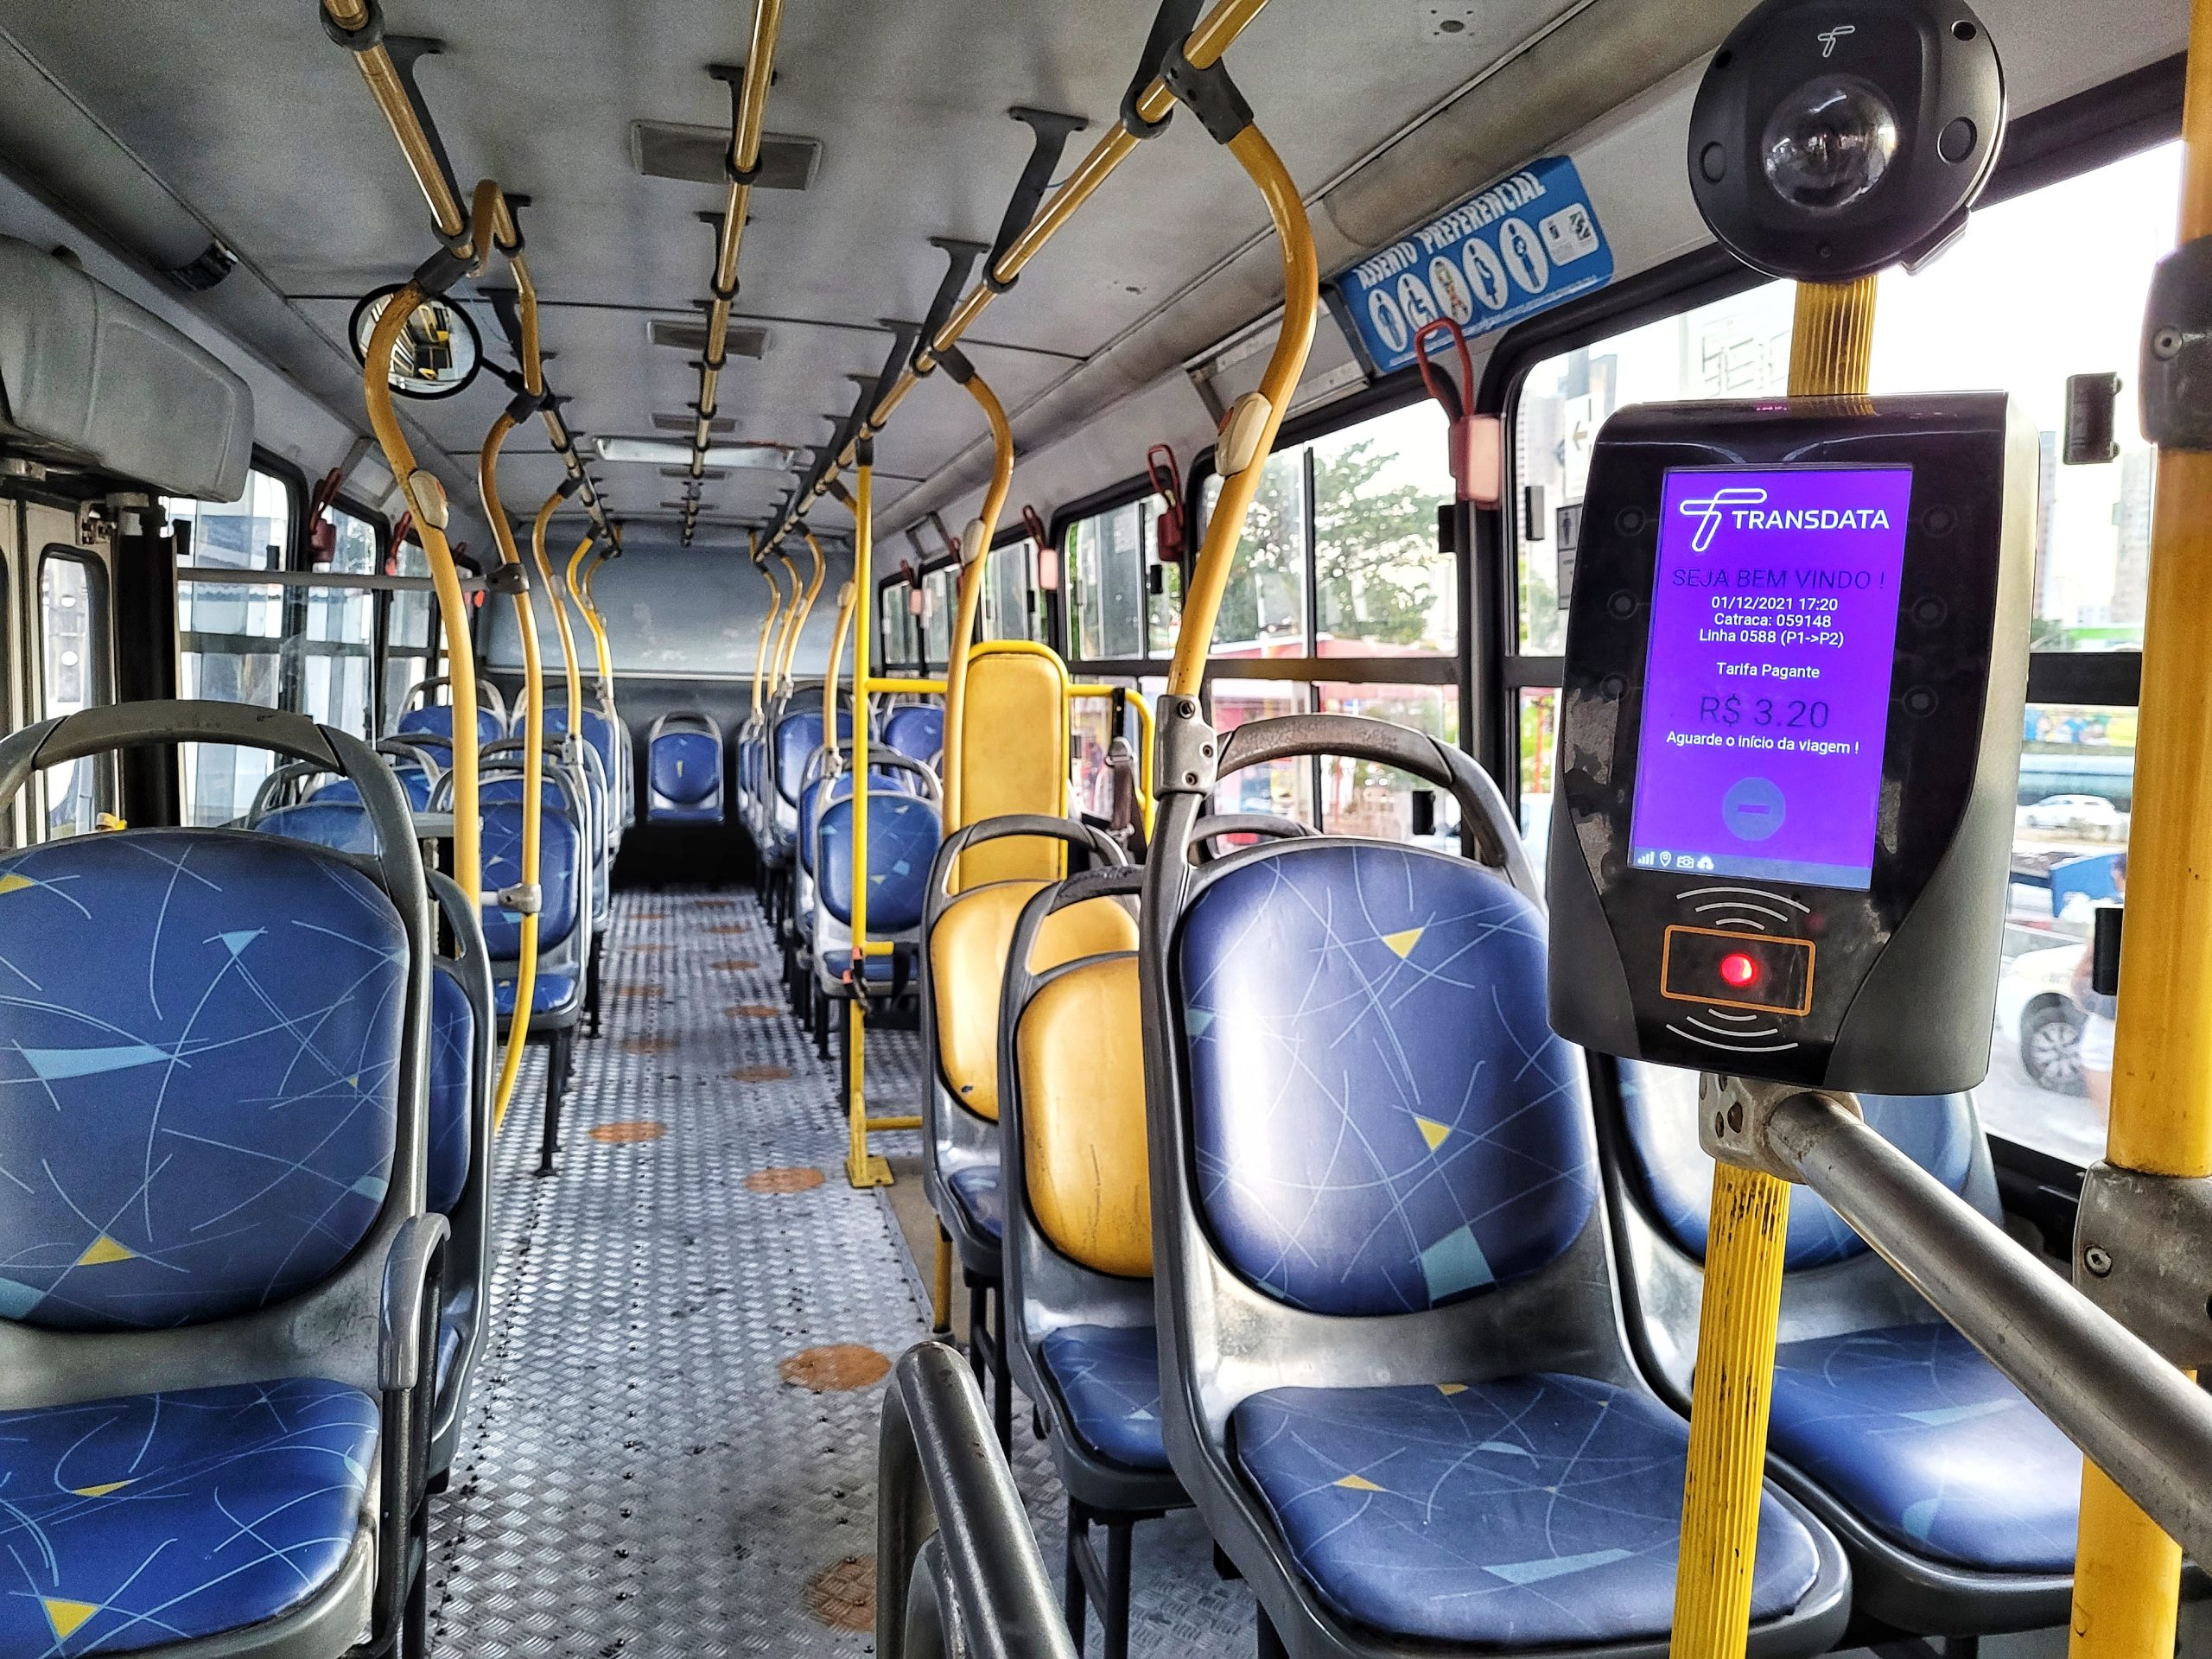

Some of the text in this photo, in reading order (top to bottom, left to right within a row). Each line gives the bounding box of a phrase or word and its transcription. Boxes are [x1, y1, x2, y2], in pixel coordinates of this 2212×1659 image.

[1413, 172, 1547, 255] PREFERENCIAL
[1731, 509, 1891, 530] TRANSDATA
[1672, 568, 1729, 588] SEJA
[1737, 569, 1788, 589] BEM
[1795, 569, 1871, 589] VINDO
[1711, 596, 1838, 612] 01/12/2021 17:20
[1713, 613, 1832, 628] Catraca: 059148
[1699, 628, 1844, 648] Linha 0588 (P1->P2)
[1716, 662, 1821, 680] Tarifa Pagante
[1699, 693, 1830, 728] R$ 3.20
[1666, 731, 1723, 747] Aguarde
[1726, 737, 1735, 747] o
[1738, 734, 1774, 750] início
[1777, 737, 1795, 751] da
[1799, 740, 1851, 755] viagem
